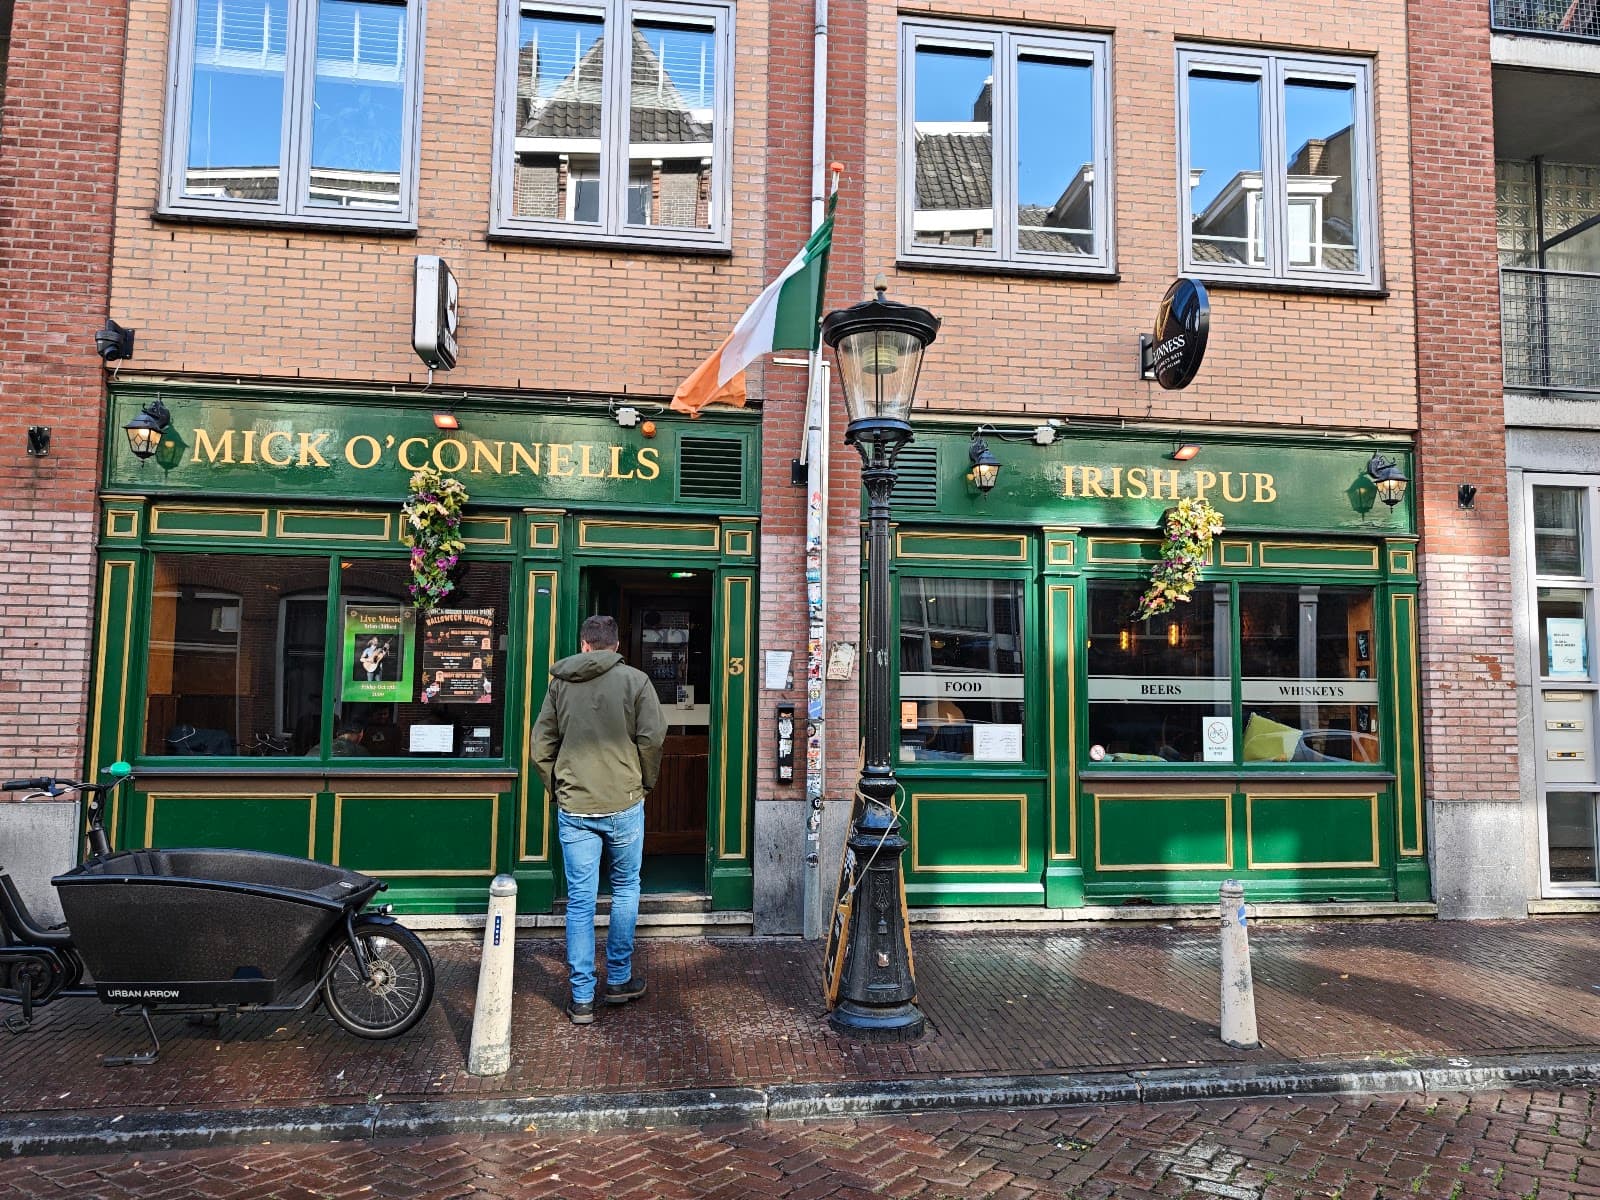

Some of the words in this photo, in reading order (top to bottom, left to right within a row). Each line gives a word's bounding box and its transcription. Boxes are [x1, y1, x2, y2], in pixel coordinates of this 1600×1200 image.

[190, 428, 331, 467] MICK
[344, 434, 660, 481] O'CONNELLS
[1062, 465, 1180, 500] IRISH
[1194, 470, 1277, 503] PUB
[360, 614, 377, 623] Live
[378, 615, 402, 623] Music
[425, 614, 462, 626] HALLOWEEN
[463, 614, 493, 627] WEEKEND
[728, 657, 745, 676] 3
[944, 681, 982, 692] FOOD
[1140, 684, 1182, 696] BEERS
[1278, 685, 1344, 698] WHISKEYS
[107, 989, 142, 998] URBAN
[143, 990, 180, 998] ARROW
